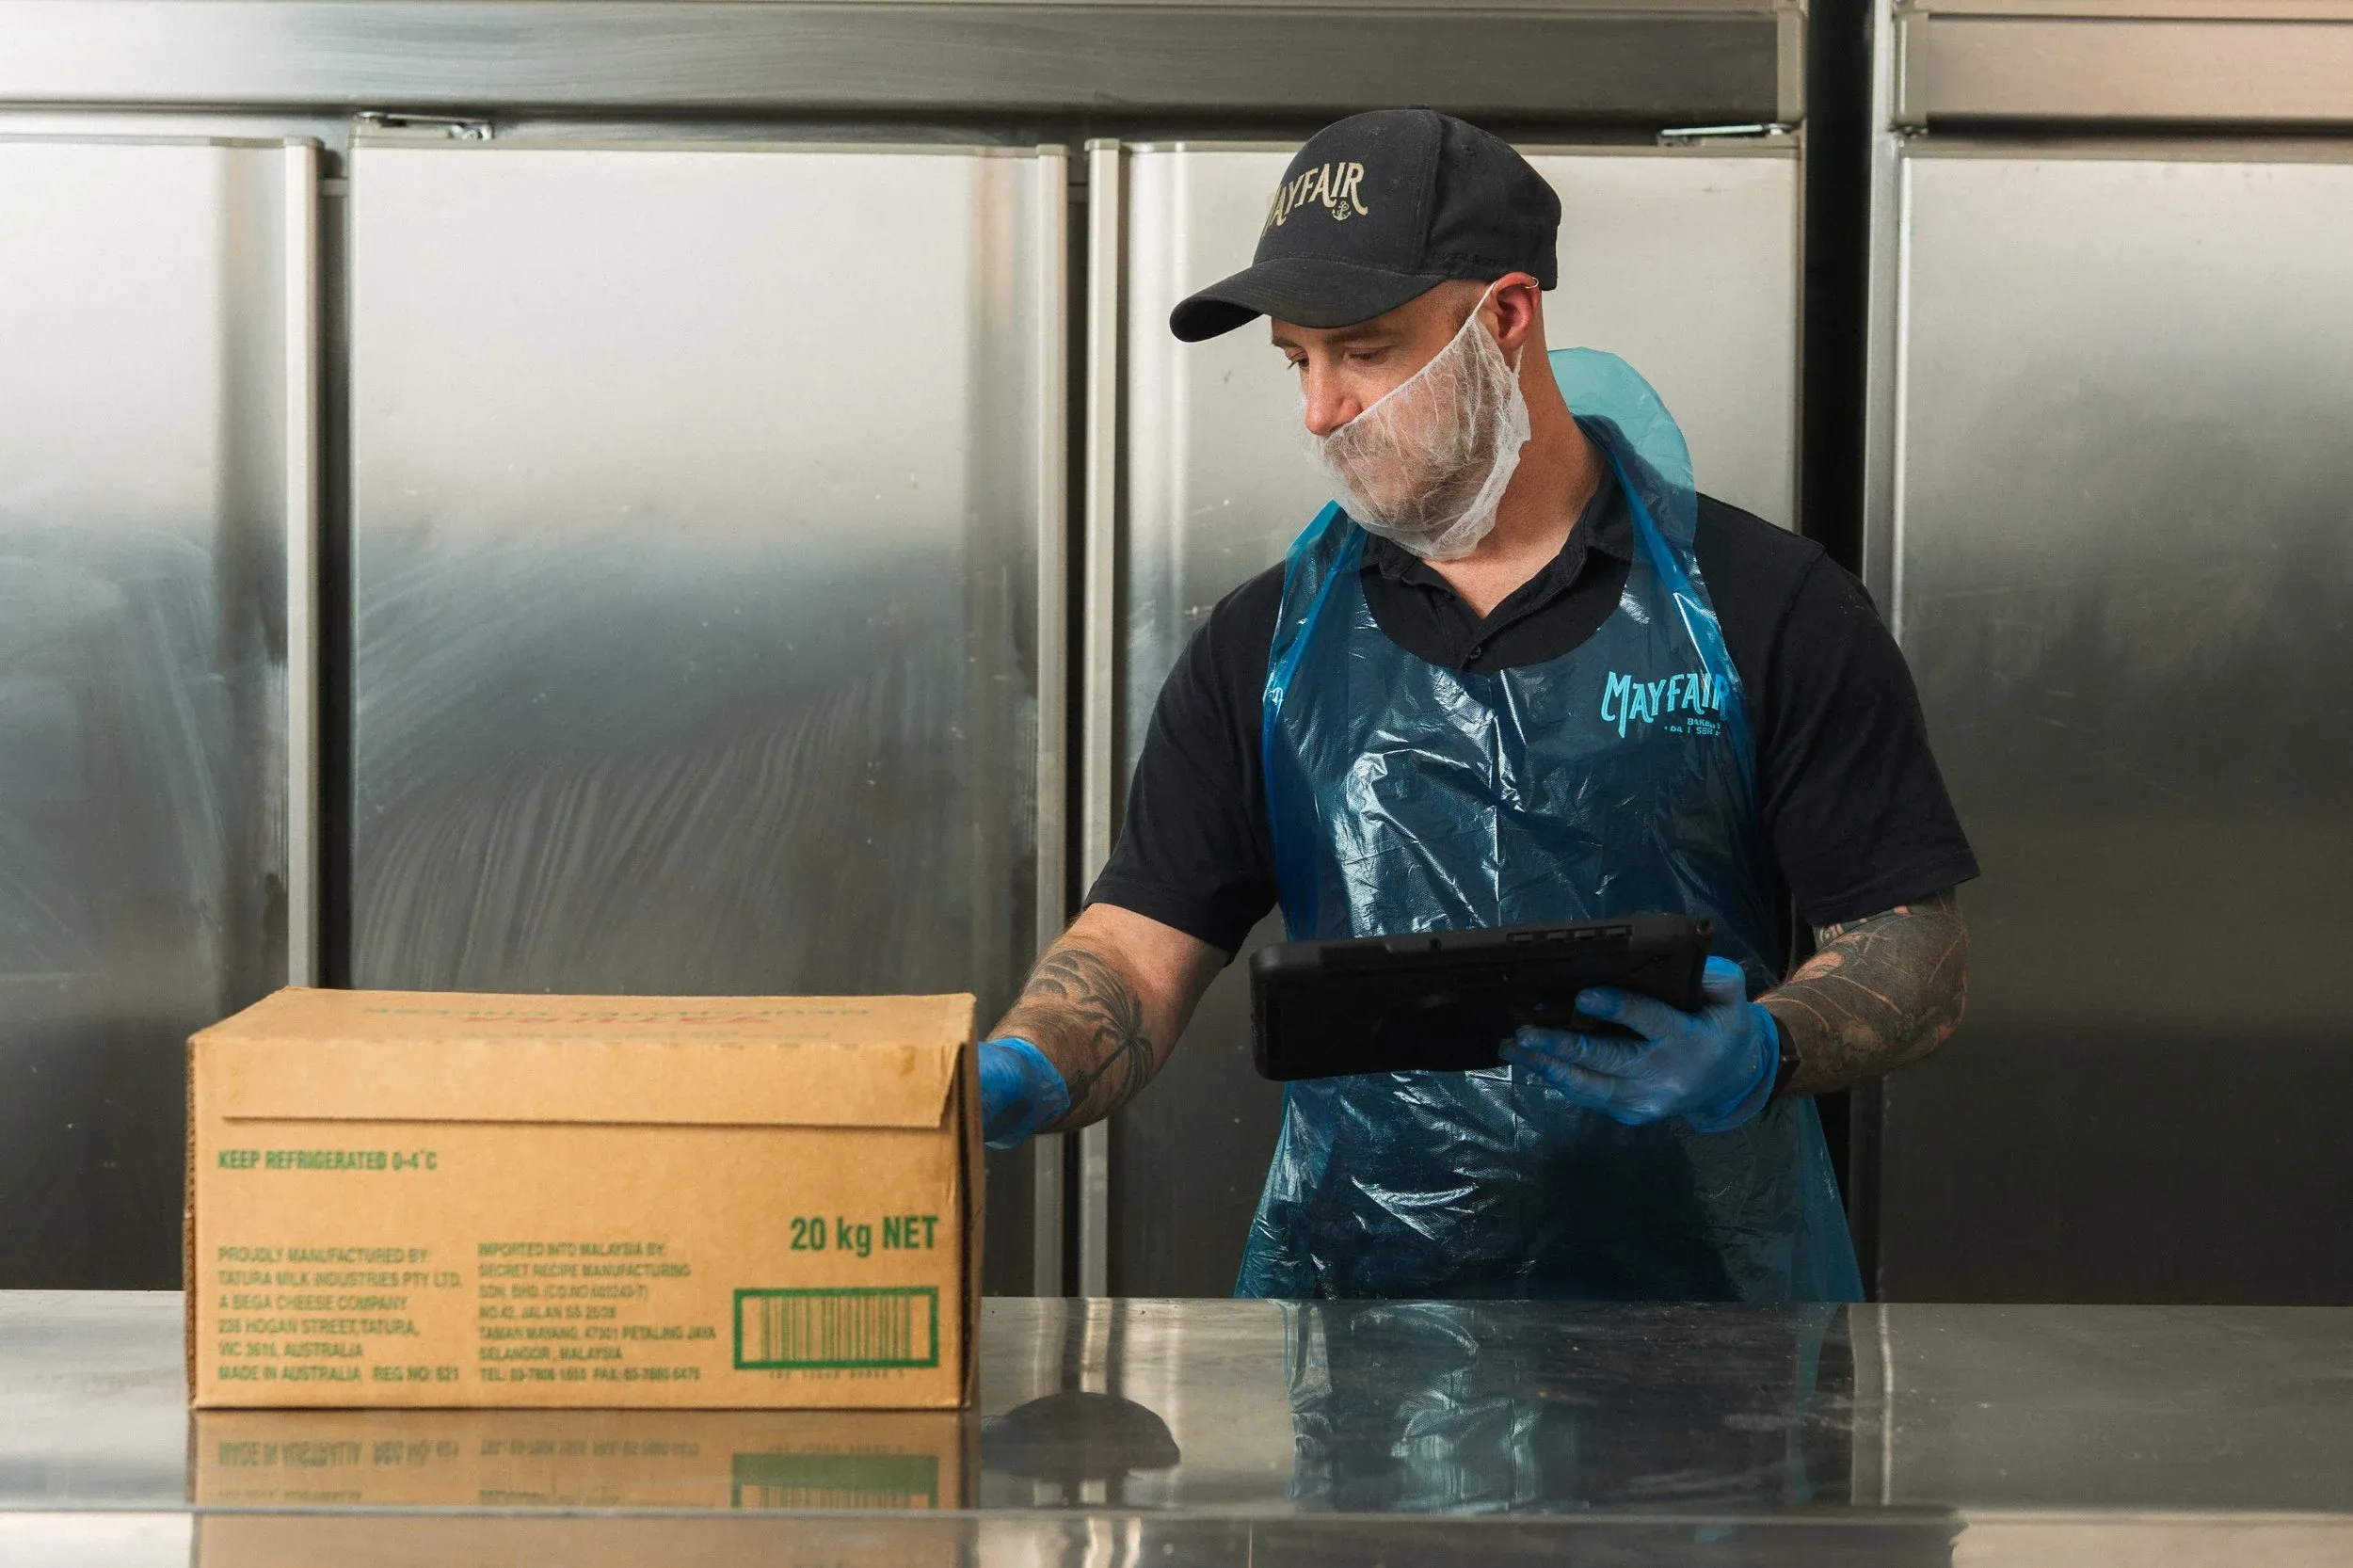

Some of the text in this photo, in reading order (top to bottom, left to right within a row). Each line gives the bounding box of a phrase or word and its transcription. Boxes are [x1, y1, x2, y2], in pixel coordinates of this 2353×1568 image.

[1601, 671, 1729, 739] MAYFAIR
[217, 1149, 261, 1170] KEEP
[265, 1149, 387, 1170] REFRIGERATED
[791, 1214, 939, 1258] 20 kg NET
[217, 1246, 284, 1262] PROUDLY
[287, 1246, 405, 1262] MANUFACTURED
[478, 1241, 544, 1257] IMPORTED
[580, 1241, 642, 1257] MALAYSIA
[582, 1262, 692, 1278] MANUFACTURING
[313, 1271, 399, 1288] INDUSTRIES
[401, 1272, 430, 1288] PTY
[276, 1294, 334, 1310] CHEESE
[337, 1294, 408, 1311] COMPANY
[283, 1341, 364, 1357] AUSTRALIA
[559, 1346, 623, 1361] MALAYSIA
[217, 1364, 261, 1382] MADE
[263, 1365, 279, 1381] IN
[281, 1365, 361, 1382] AUSTRALIA
[372, 1366, 404, 1383] REG
